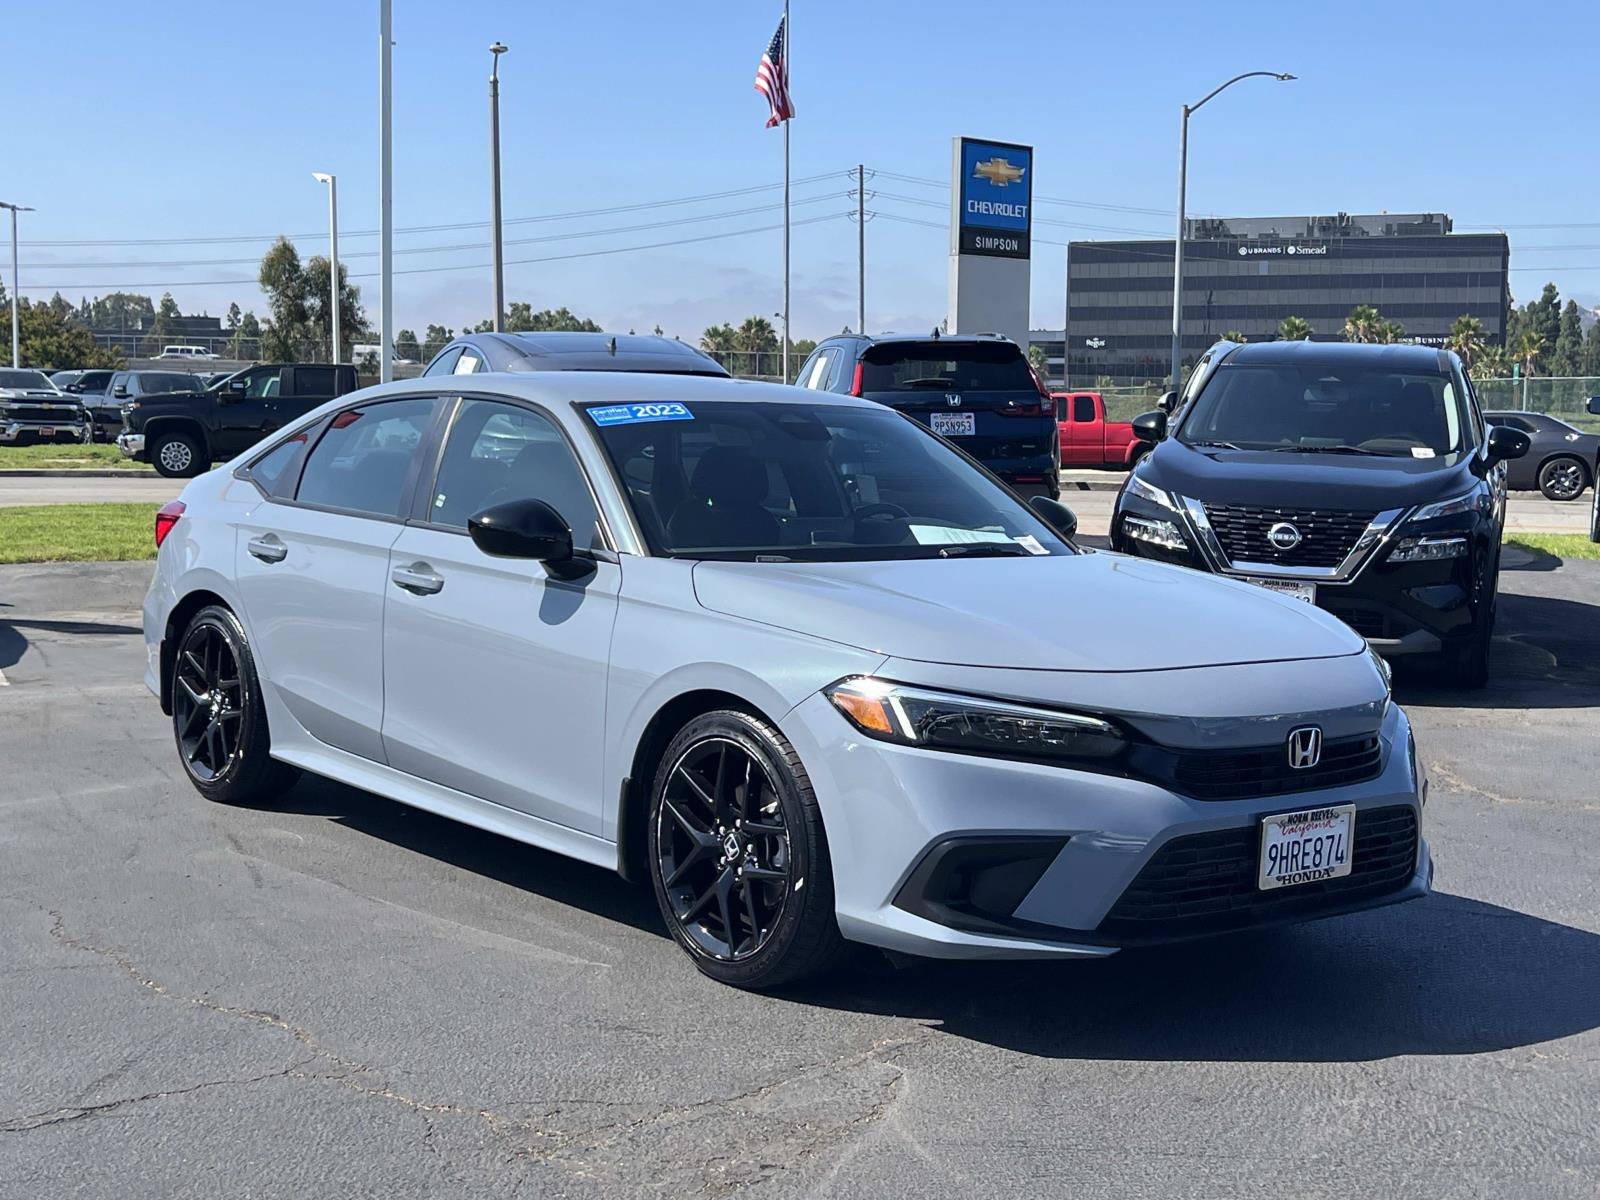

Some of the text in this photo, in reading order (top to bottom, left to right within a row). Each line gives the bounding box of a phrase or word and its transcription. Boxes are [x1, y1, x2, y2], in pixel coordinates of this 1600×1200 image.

[968, 200, 1028, 218] CHEVROLET
[975, 236, 1018, 251] SIMPSON
[1296, 245, 1327, 255] Smead
[632, 404, 686, 417] 2023
[934, 420, 972, 432] 9PSN953
[1267, 531, 1302, 541] NISSAN
[1287, 808, 1334, 824] NORM REEVES
[1282, 820, 1335, 837] California
[1266, 833, 1344, 877] 9HRE874
[1281, 868, 1331, 885] HONDA
